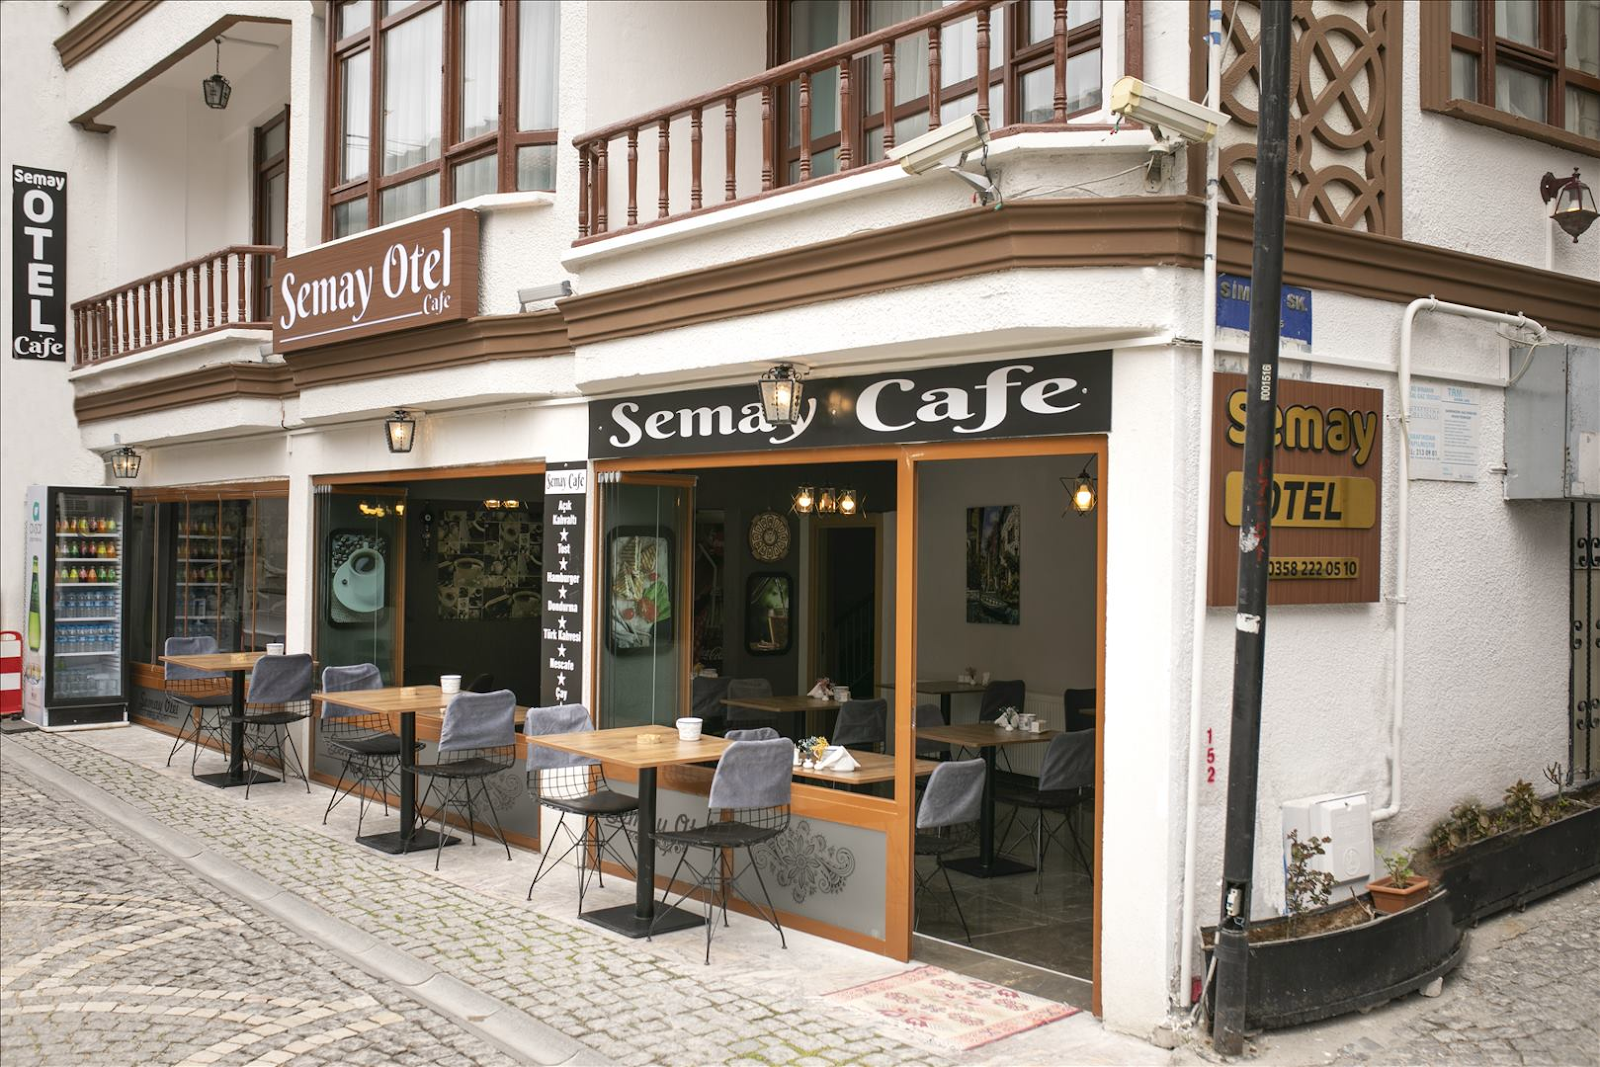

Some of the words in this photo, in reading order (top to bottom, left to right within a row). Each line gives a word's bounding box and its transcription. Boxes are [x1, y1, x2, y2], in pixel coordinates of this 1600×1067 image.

[14, 168, 65, 191] Semay
[23, 189, 56, 333] OTEL
[279, 266, 373, 331] Semay
[381, 226, 452, 299] Otel
[422, 291, 451, 316] Cafe
[13, 336, 64, 358] Cafe
[609, 396, 817, 449] Semay
[855, 364, 1081, 434] Cafe
[1227, 390, 1377, 466] Smay
[547, 473, 567, 491] Semay
[568, 472, 585, 490] Cafe
[558, 500, 573, 513] Açık
[546, 572, 580, 585] Hamburger
[1268, 561, 1297, 577] 0358
[1301, 561, 1323, 577] 222
[1325, 561, 1341, 577] 05
[1343, 561, 1357, 576] 10
[547, 600, 578, 613] Dondurma
[543, 628, 557, 640] Türk
[558, 630, 581, 643] Kahvesi
[549, 657, 575, 671] Nescafe
[555, 686, 568, 701] Çay
